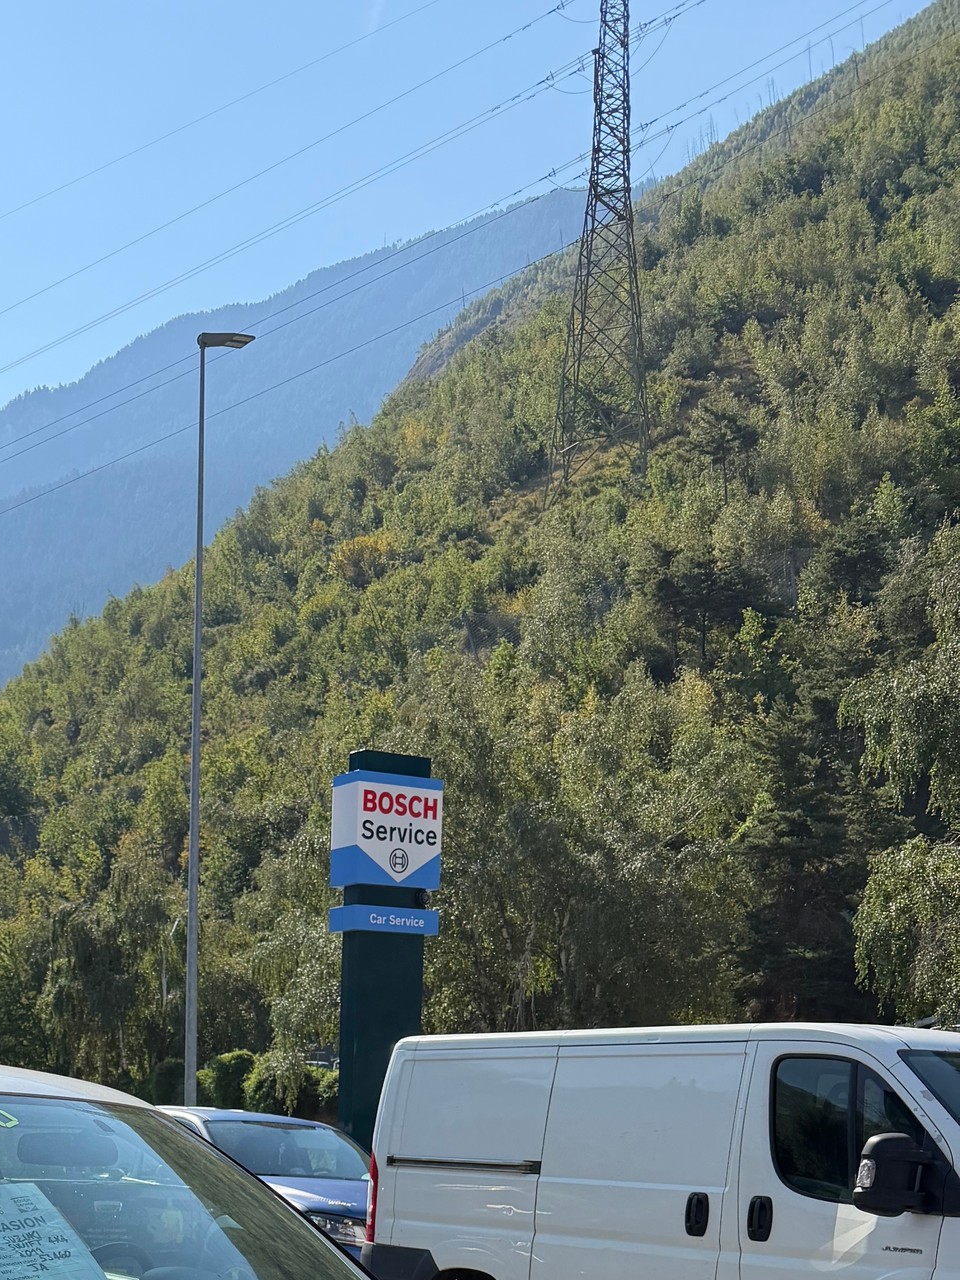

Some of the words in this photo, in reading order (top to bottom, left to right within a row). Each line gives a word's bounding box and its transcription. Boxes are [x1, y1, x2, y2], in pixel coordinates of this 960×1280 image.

[362, 789, 438, 820] BOSCH
[361, 819, 437, 846] Service
[370, 913, 386, 925] Car
[389, 914, 425, 927] Service
[3, 1231, 42, 1244] SUZUKI
[8, 1240, 42, 1251] SWIFT
[27, 1263, 49, 1272] JA
